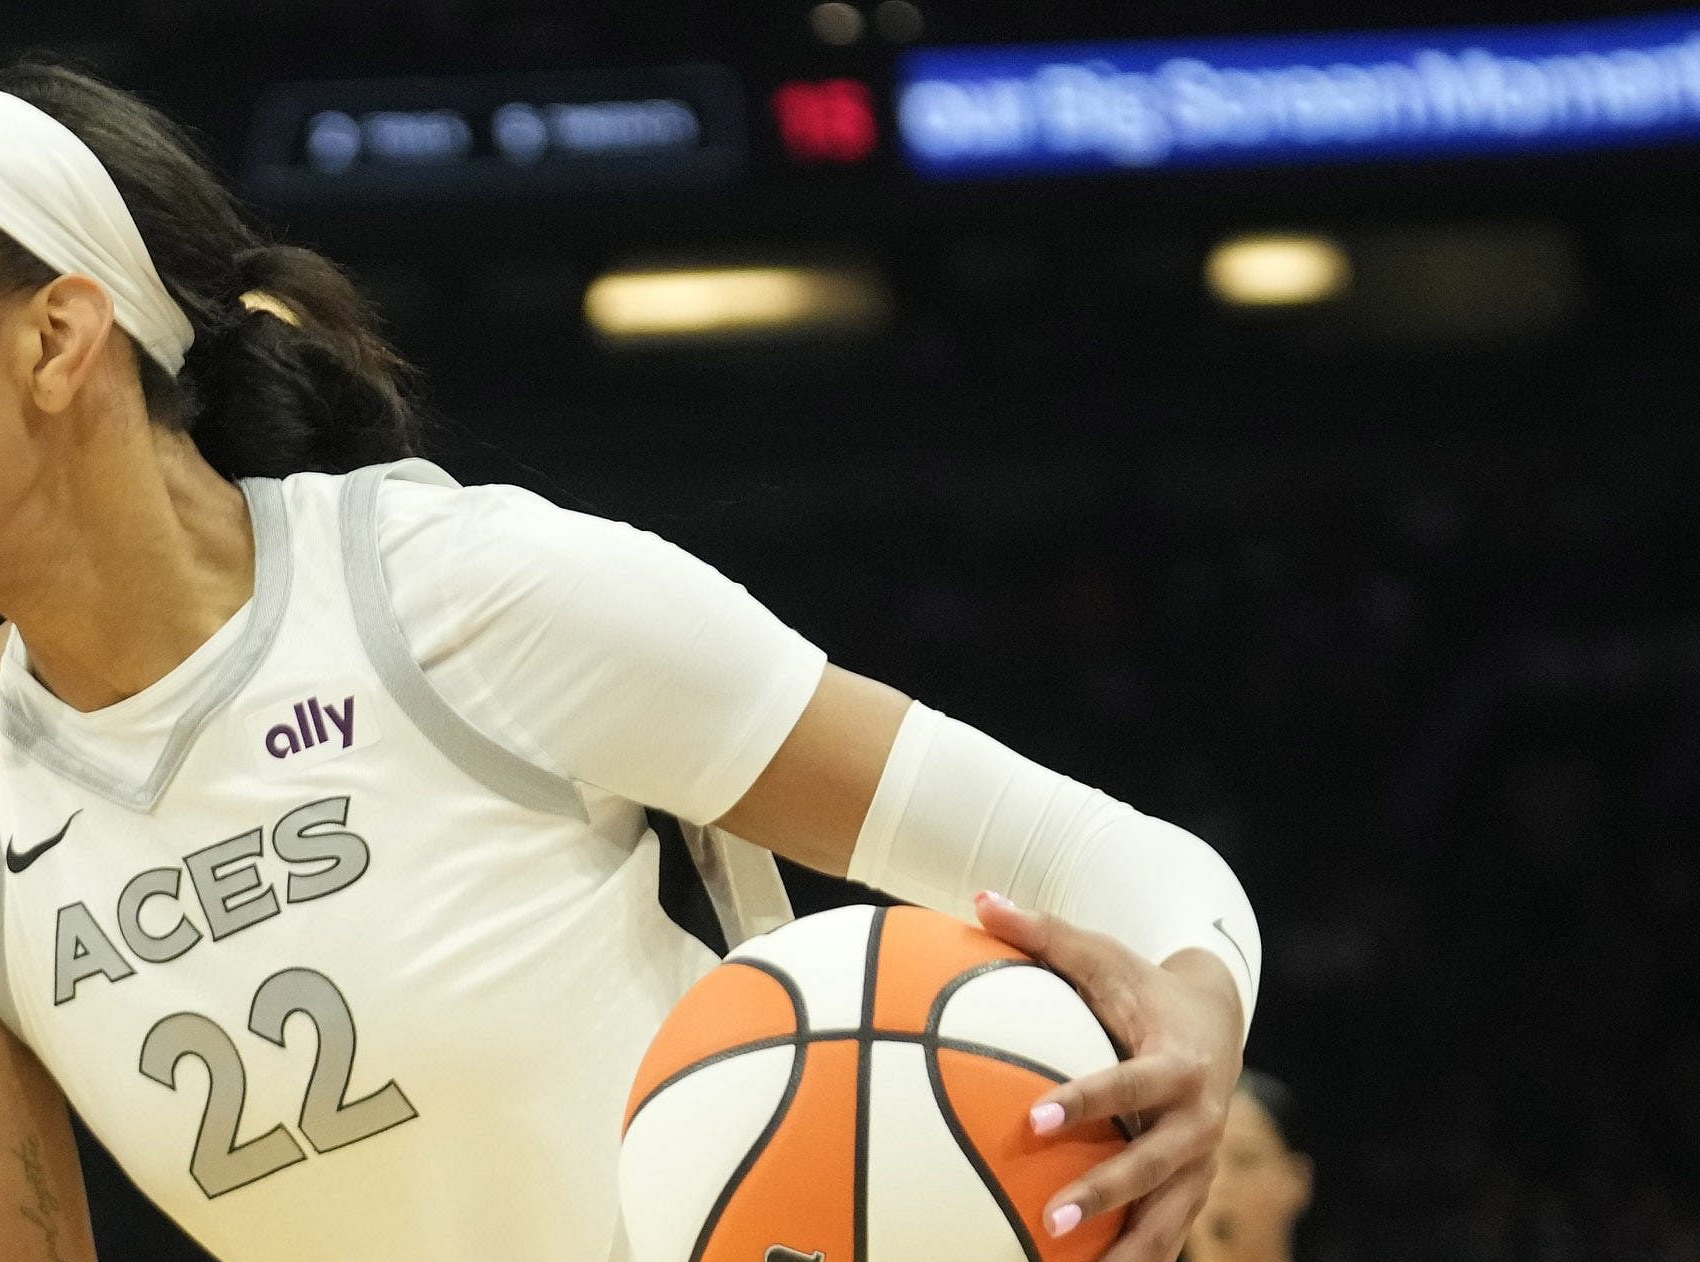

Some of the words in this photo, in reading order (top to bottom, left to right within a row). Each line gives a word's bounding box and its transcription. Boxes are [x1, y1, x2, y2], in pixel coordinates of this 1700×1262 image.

[265, 696, 355, 759] ally
[54, 796, 370, 1006] ACES
[139, 966, 419, 1199] 22
